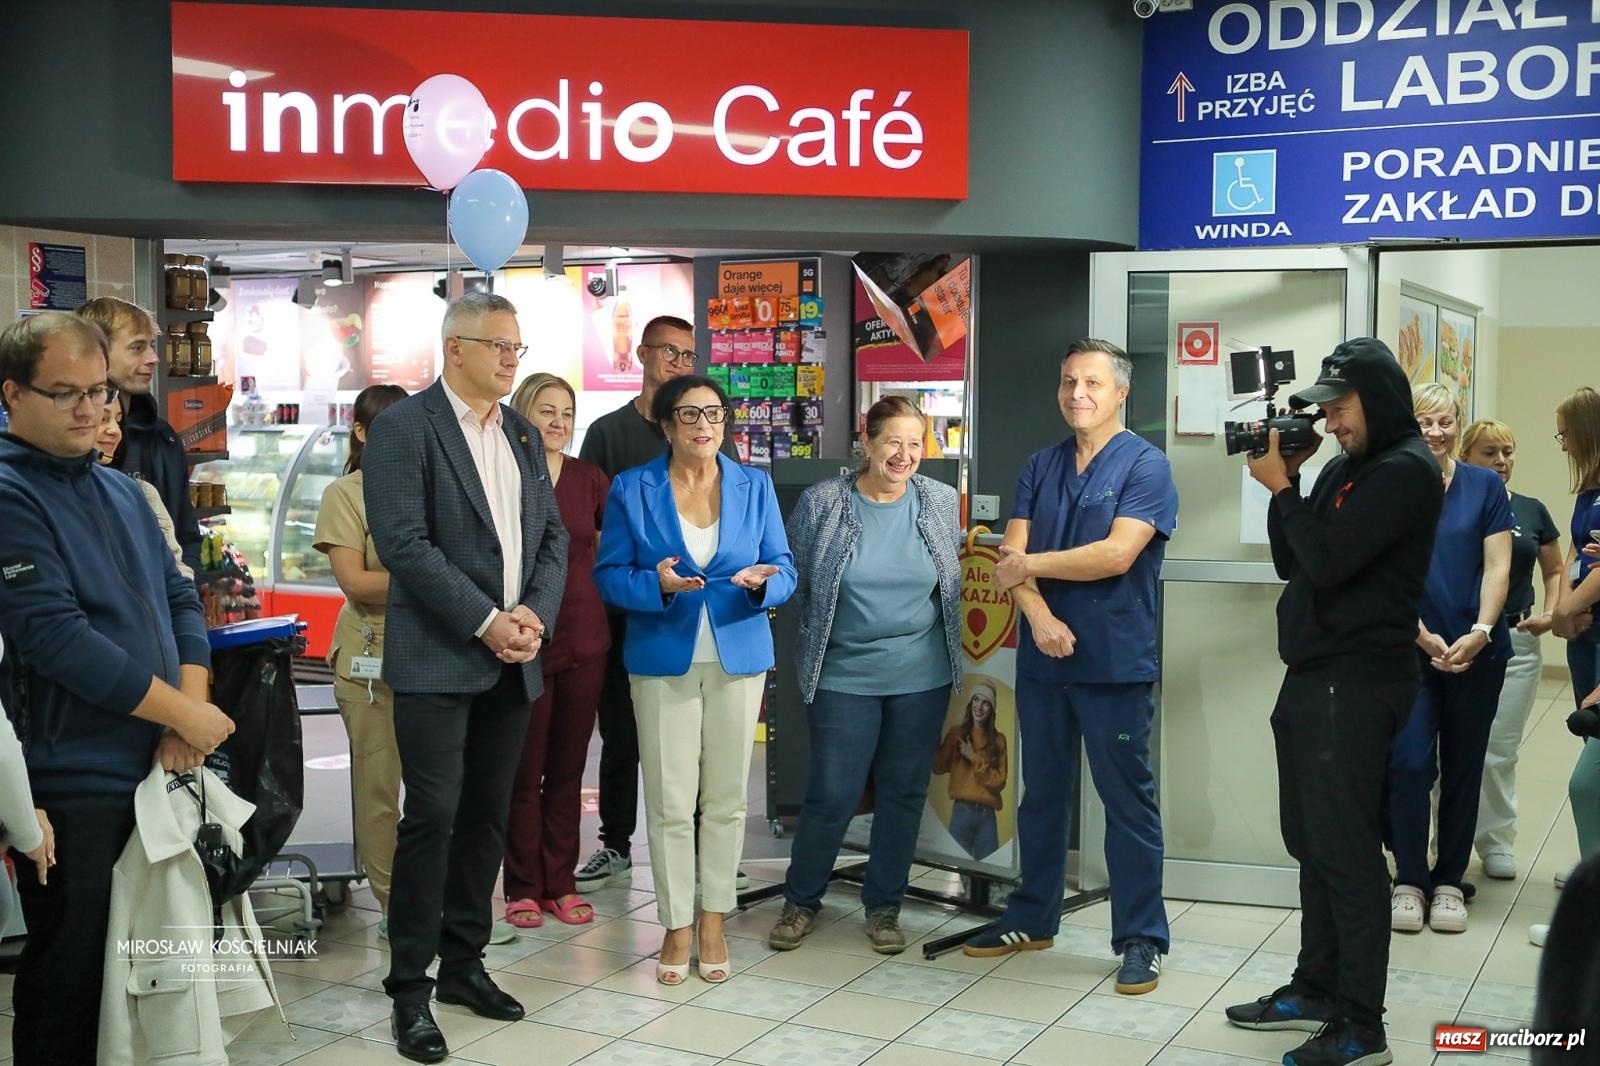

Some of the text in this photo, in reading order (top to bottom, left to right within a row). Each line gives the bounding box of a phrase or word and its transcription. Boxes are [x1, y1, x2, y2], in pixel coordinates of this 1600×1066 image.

[1208, 0, 1567, 54] ODDZIAŁ
[1226, 70, 1287, 94] IZBA
[1198, 89, 1316, 120] PRZYJĘĆ
[222, 70, 924, 169] inmedio Café
[1342, 138, 1600, 182] PORADNIE
[1342, 184, 1600, 224] ZAKŁAD D
[1194, 221, 1293, 240] WINDA
[723, 270, 763, 281] Orange
[802, 268, 814, 277] 5G
[723, 281, 783, 296] daje więcej
[805, 406, 818, 419] 30
[965, 566, 990, 583] Ale
[960, 587, 1010, 606] KAZJA
